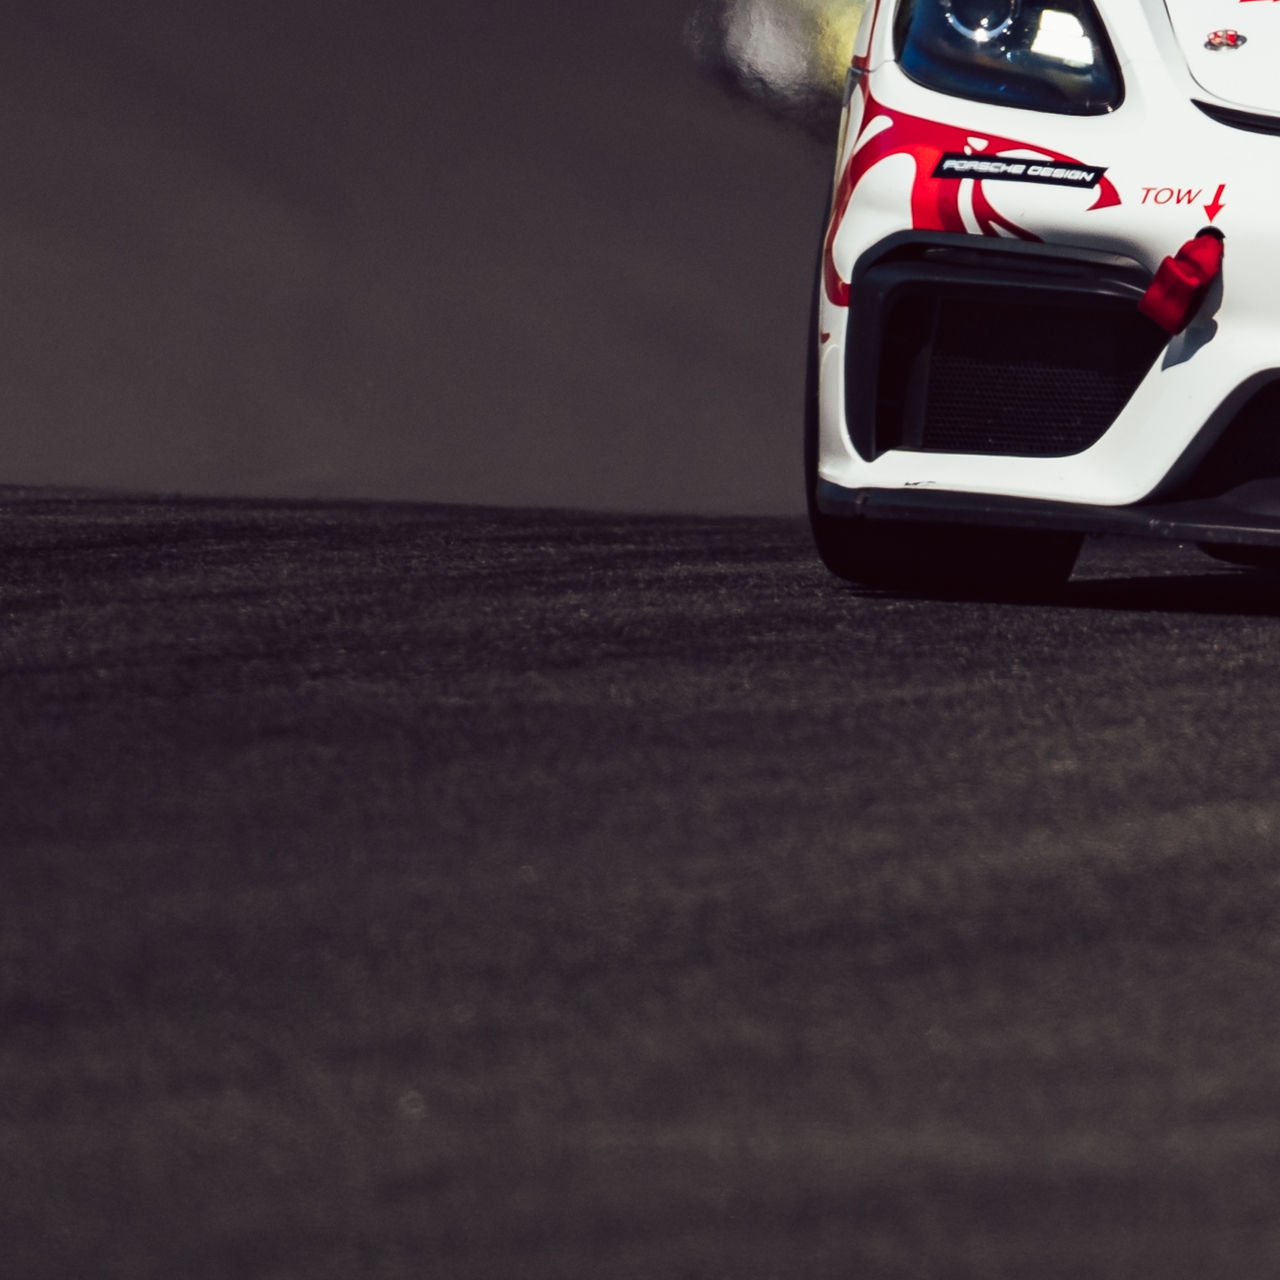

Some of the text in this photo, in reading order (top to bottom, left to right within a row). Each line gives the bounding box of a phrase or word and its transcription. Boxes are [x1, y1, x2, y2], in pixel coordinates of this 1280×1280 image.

[943, 159, 1095, 182] PORSCHE DESIGN
[1140, 188, 1202, 205] TOW
